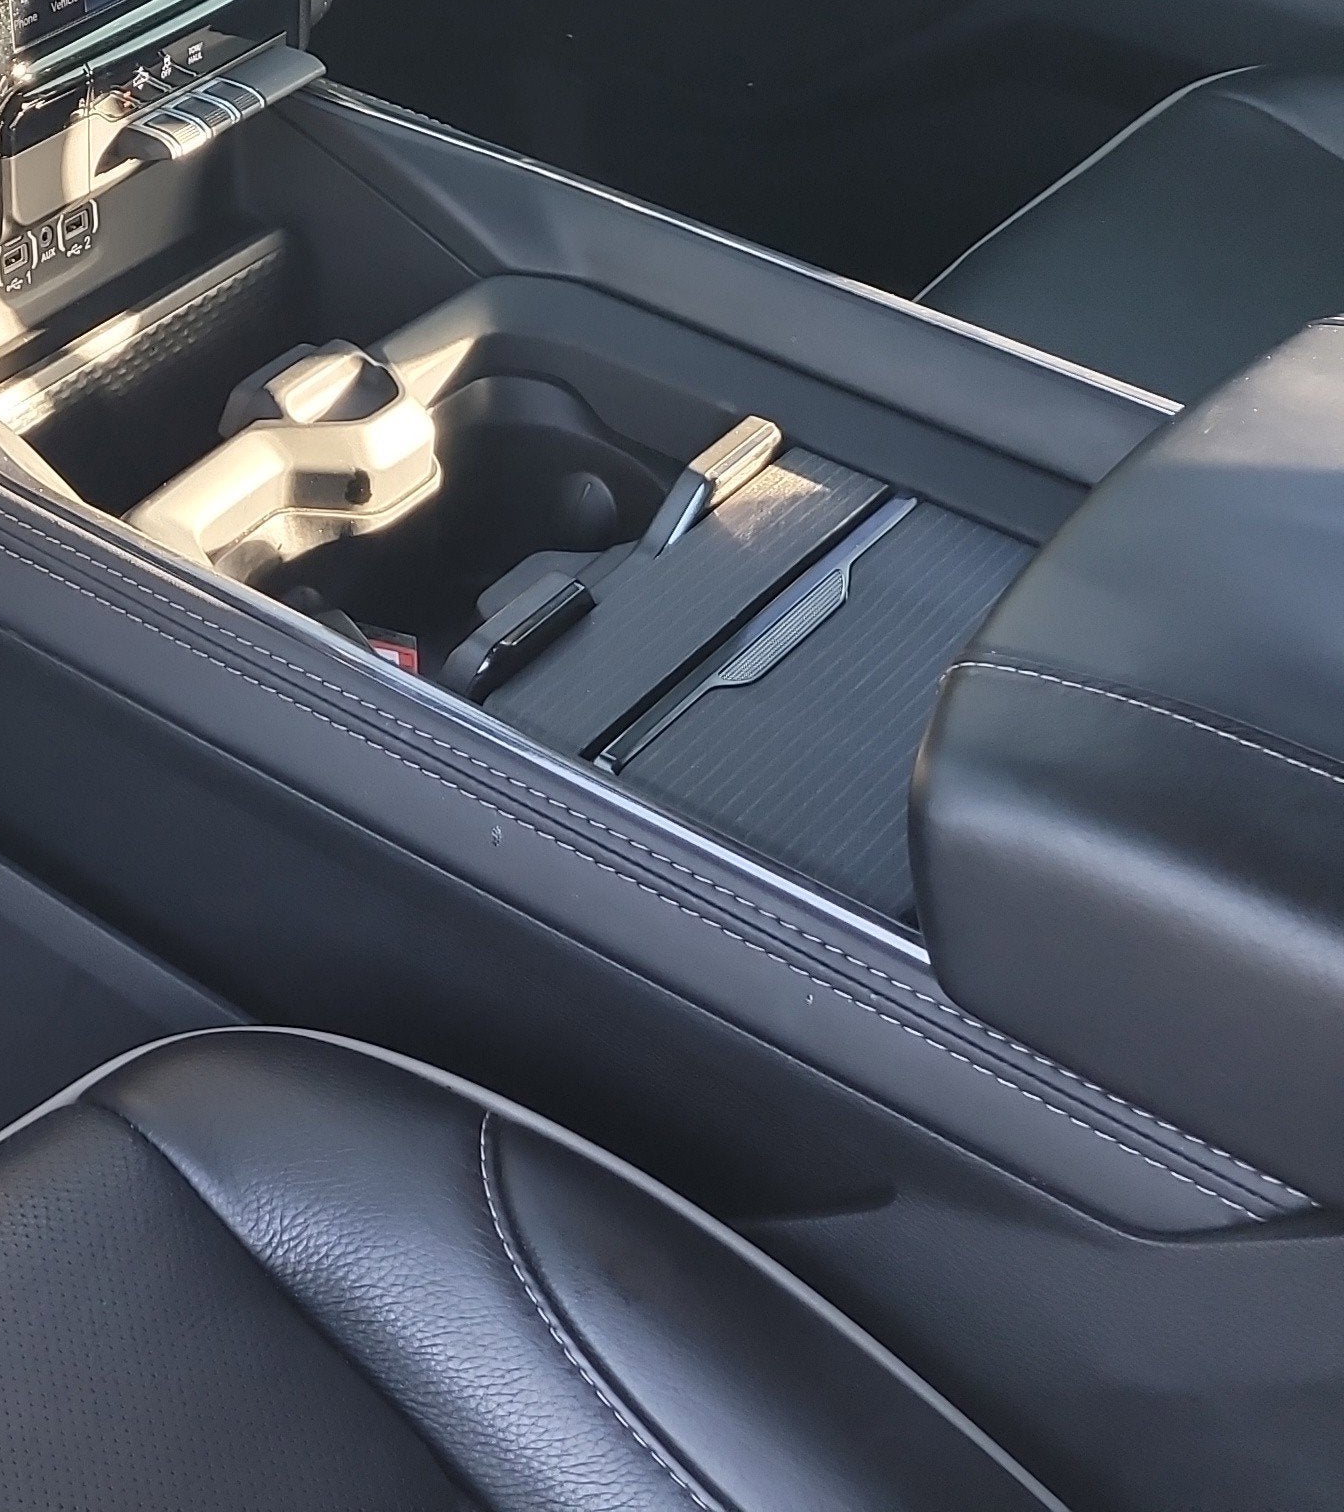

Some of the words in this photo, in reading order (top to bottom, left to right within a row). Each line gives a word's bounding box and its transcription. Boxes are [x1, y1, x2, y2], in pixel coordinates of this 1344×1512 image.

[13, 12, 38, 31] Phone
[83, 235, 92, 250] 2
[40, 246, 57, 263] AUX
